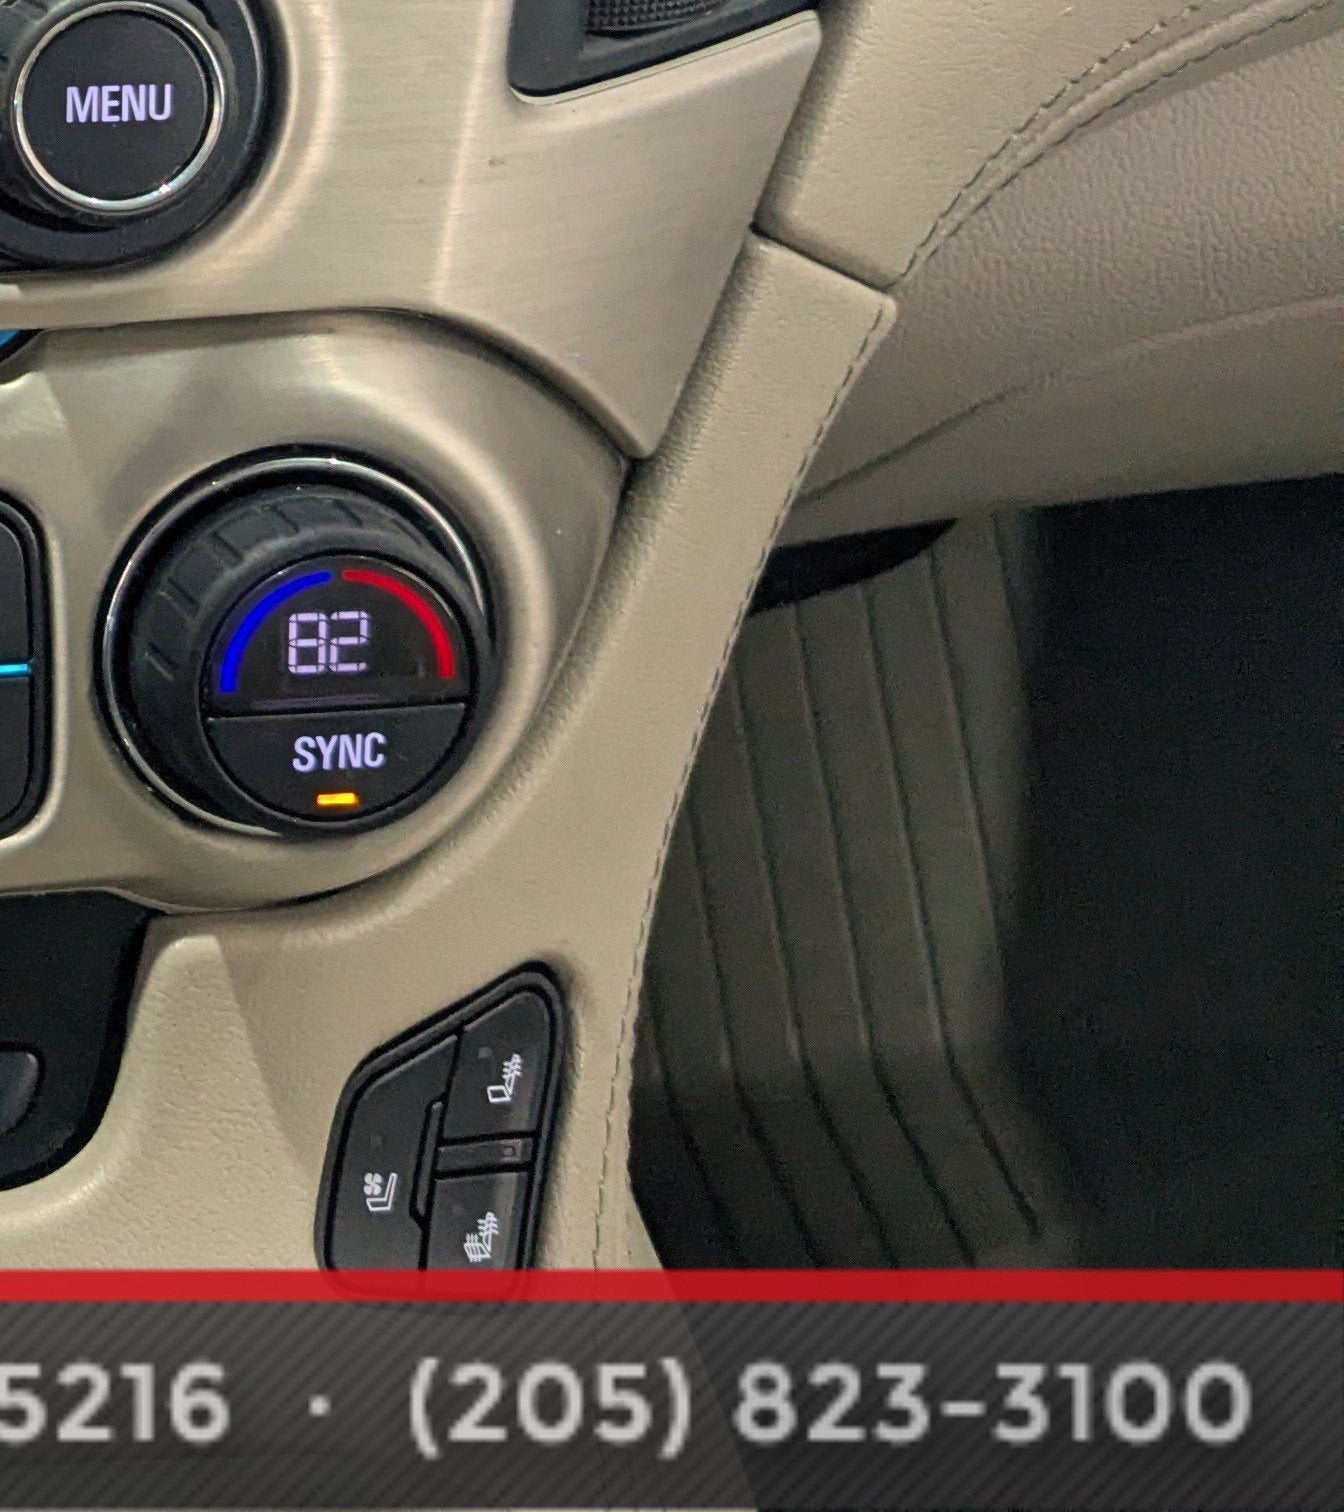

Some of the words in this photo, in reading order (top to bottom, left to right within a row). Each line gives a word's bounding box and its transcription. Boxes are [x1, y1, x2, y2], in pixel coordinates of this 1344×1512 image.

[66, 84, 171, 122] MENU
[288, 611, 368, 674] 82
[293, 732, 386, 772] SYNC
